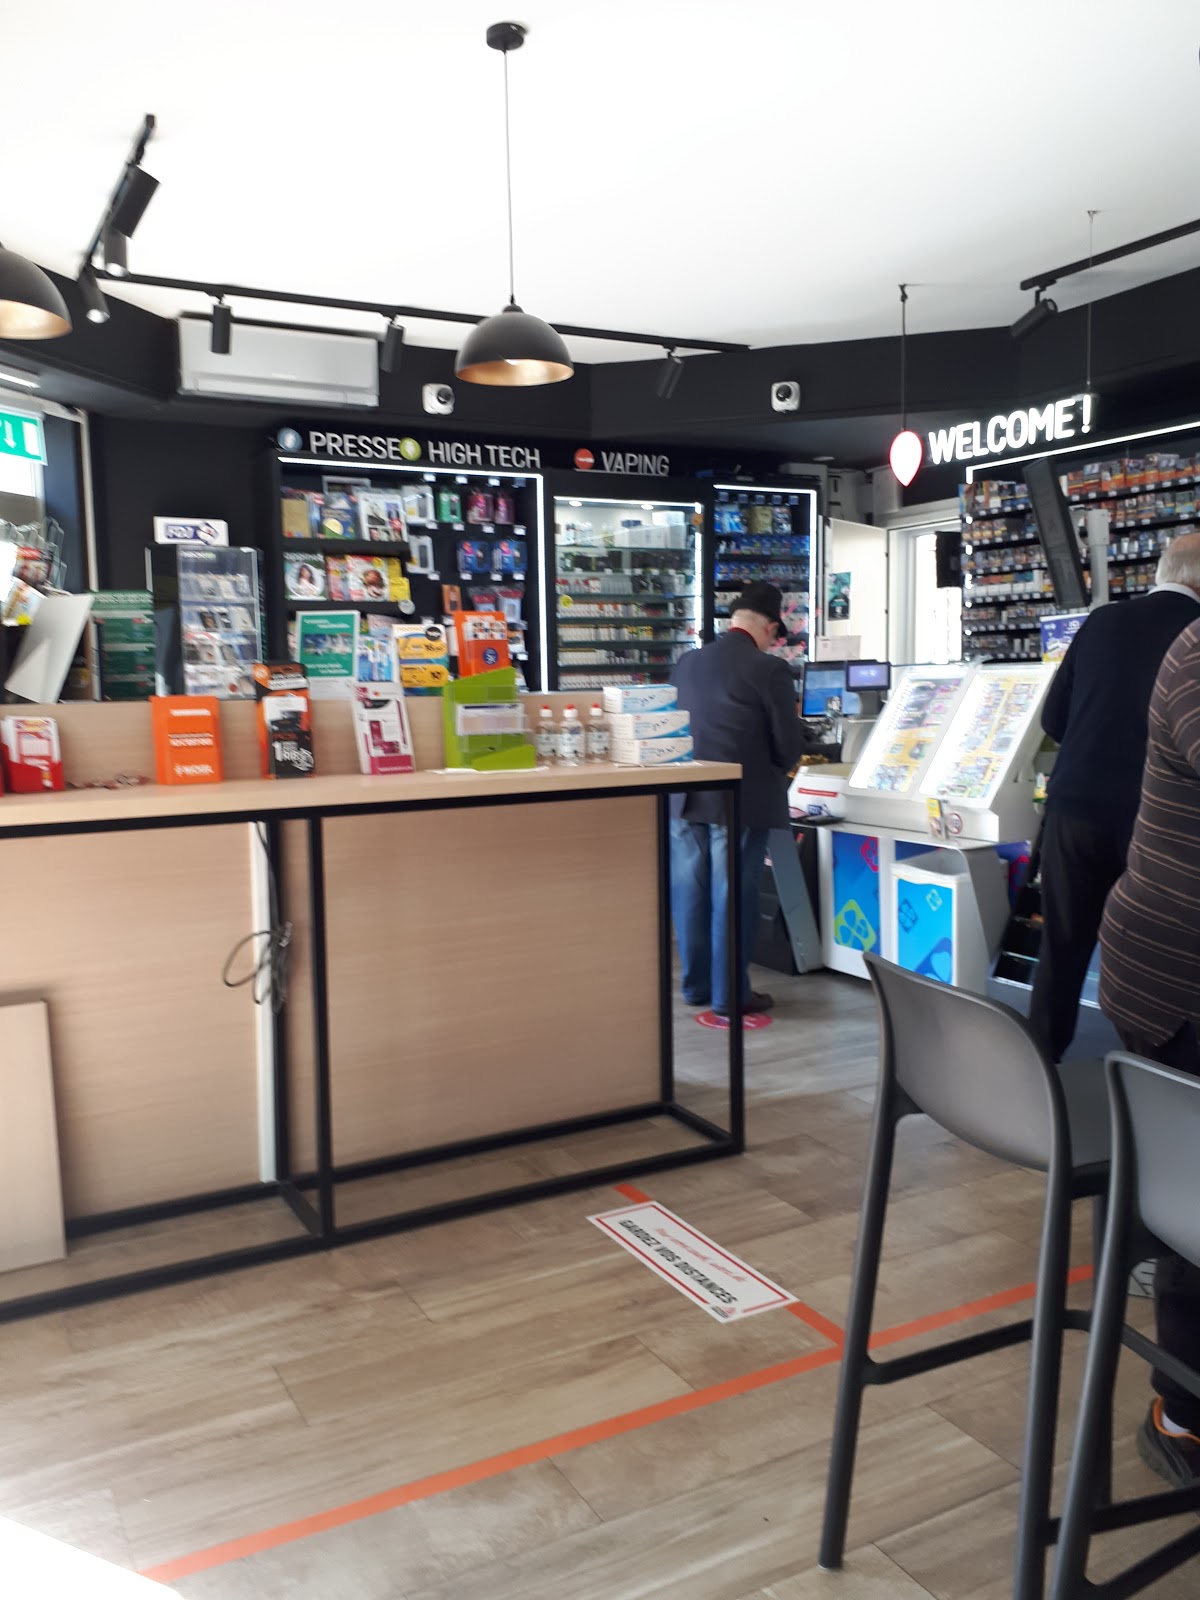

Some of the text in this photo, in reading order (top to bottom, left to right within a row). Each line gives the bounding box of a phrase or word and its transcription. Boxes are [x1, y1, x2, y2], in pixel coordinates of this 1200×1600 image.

[309, 430, 404, 461] PRESSE
[428, 440, 542, 470] HIGH TECH
[601, 450, 671, 476] VAPING
[618, 1218, 661, 1248] GARDEZ
[654, 1244, 681, 1264] VOS
[672, 1259, 738, 1305] DISTANCES
